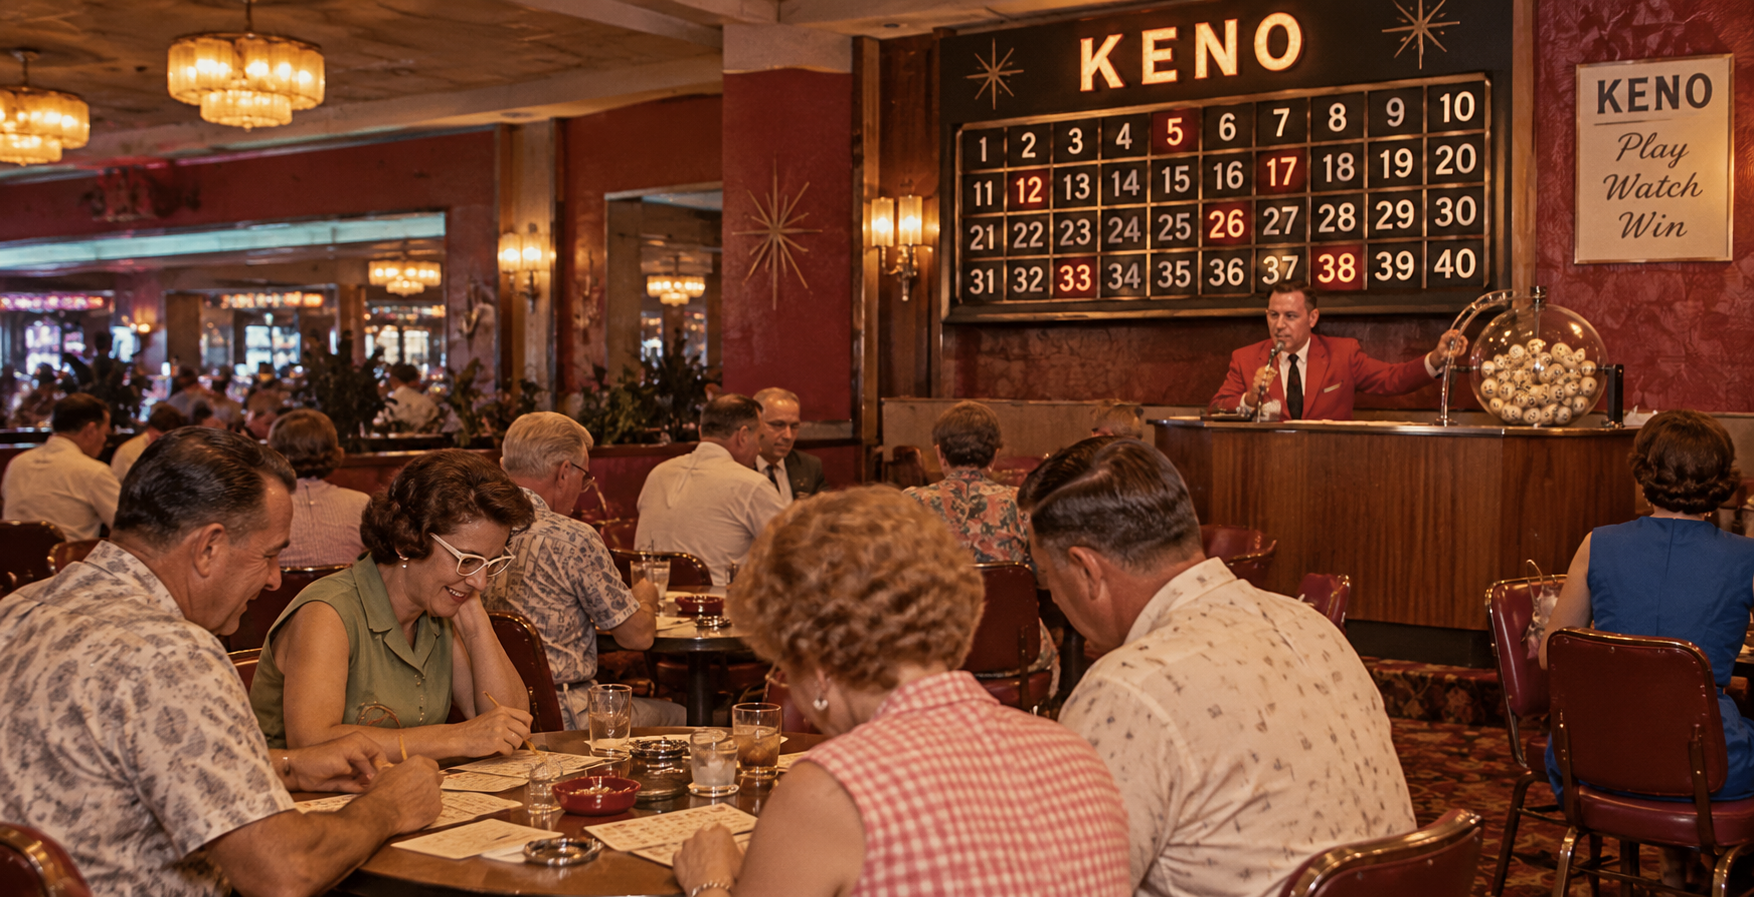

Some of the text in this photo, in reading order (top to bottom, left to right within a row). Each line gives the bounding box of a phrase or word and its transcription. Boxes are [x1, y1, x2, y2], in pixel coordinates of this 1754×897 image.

[1079, 12, 1303, 92] KENO
[1597, 73, 1713, 114] KENO
[979, 91, 1475, 162] 1 2 3 4 5 6 7 8 9 10
[1616, 132, 1689, 169] Play
[973, 143, 1477, 207] 11 12 13 14 15 16 17 18 19 20
[1603, 172, 1703, 200] Watch
[970, 195, 1477, 251] 21 22 23 24 25 26 27 28 29 30
[1618, 211, 1688, 239] Win
[969, 248, 1476, 295] 31 32 33 34 35 36 37 38 39 40
